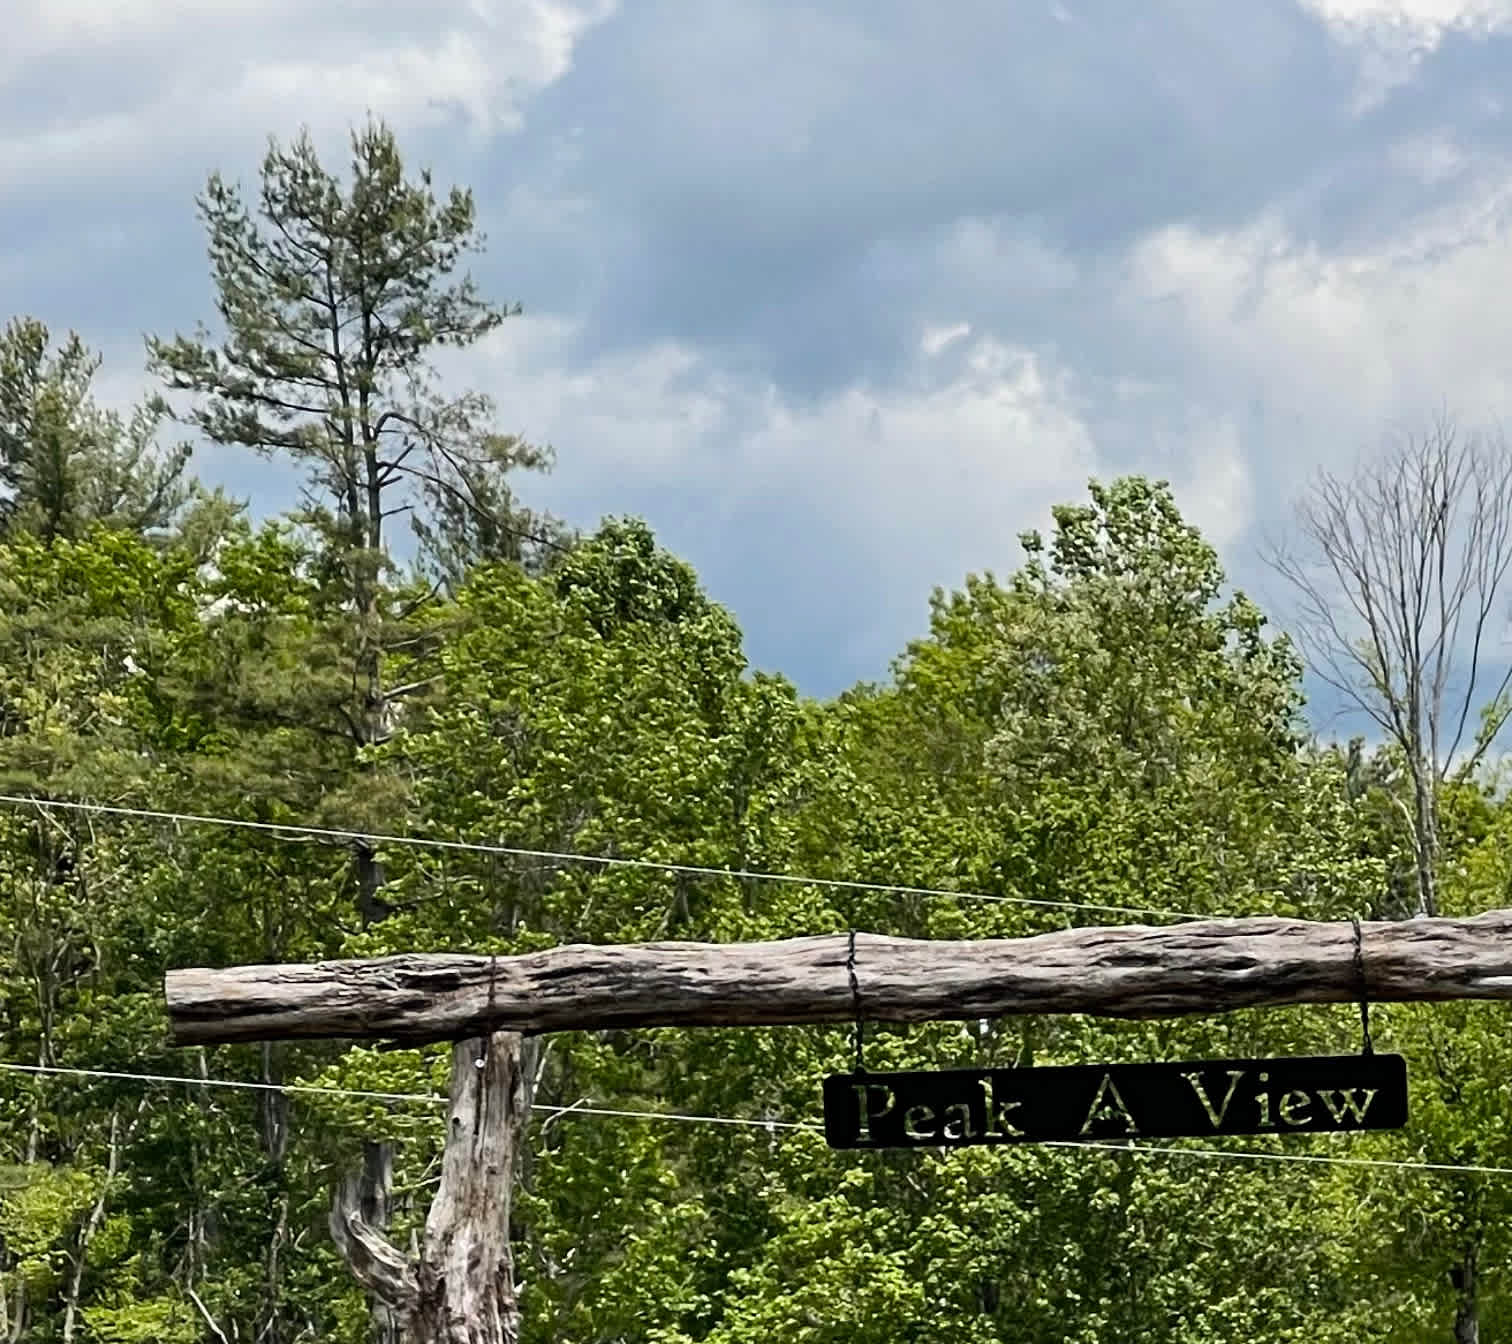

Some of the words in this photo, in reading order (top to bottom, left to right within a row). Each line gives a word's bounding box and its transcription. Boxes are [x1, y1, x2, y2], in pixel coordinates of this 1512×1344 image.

[851, 1076, 1024, 1142] Peak
[1078, 1072, 1141, 1136] A
[1180, 1070, 1380, 1128] View
